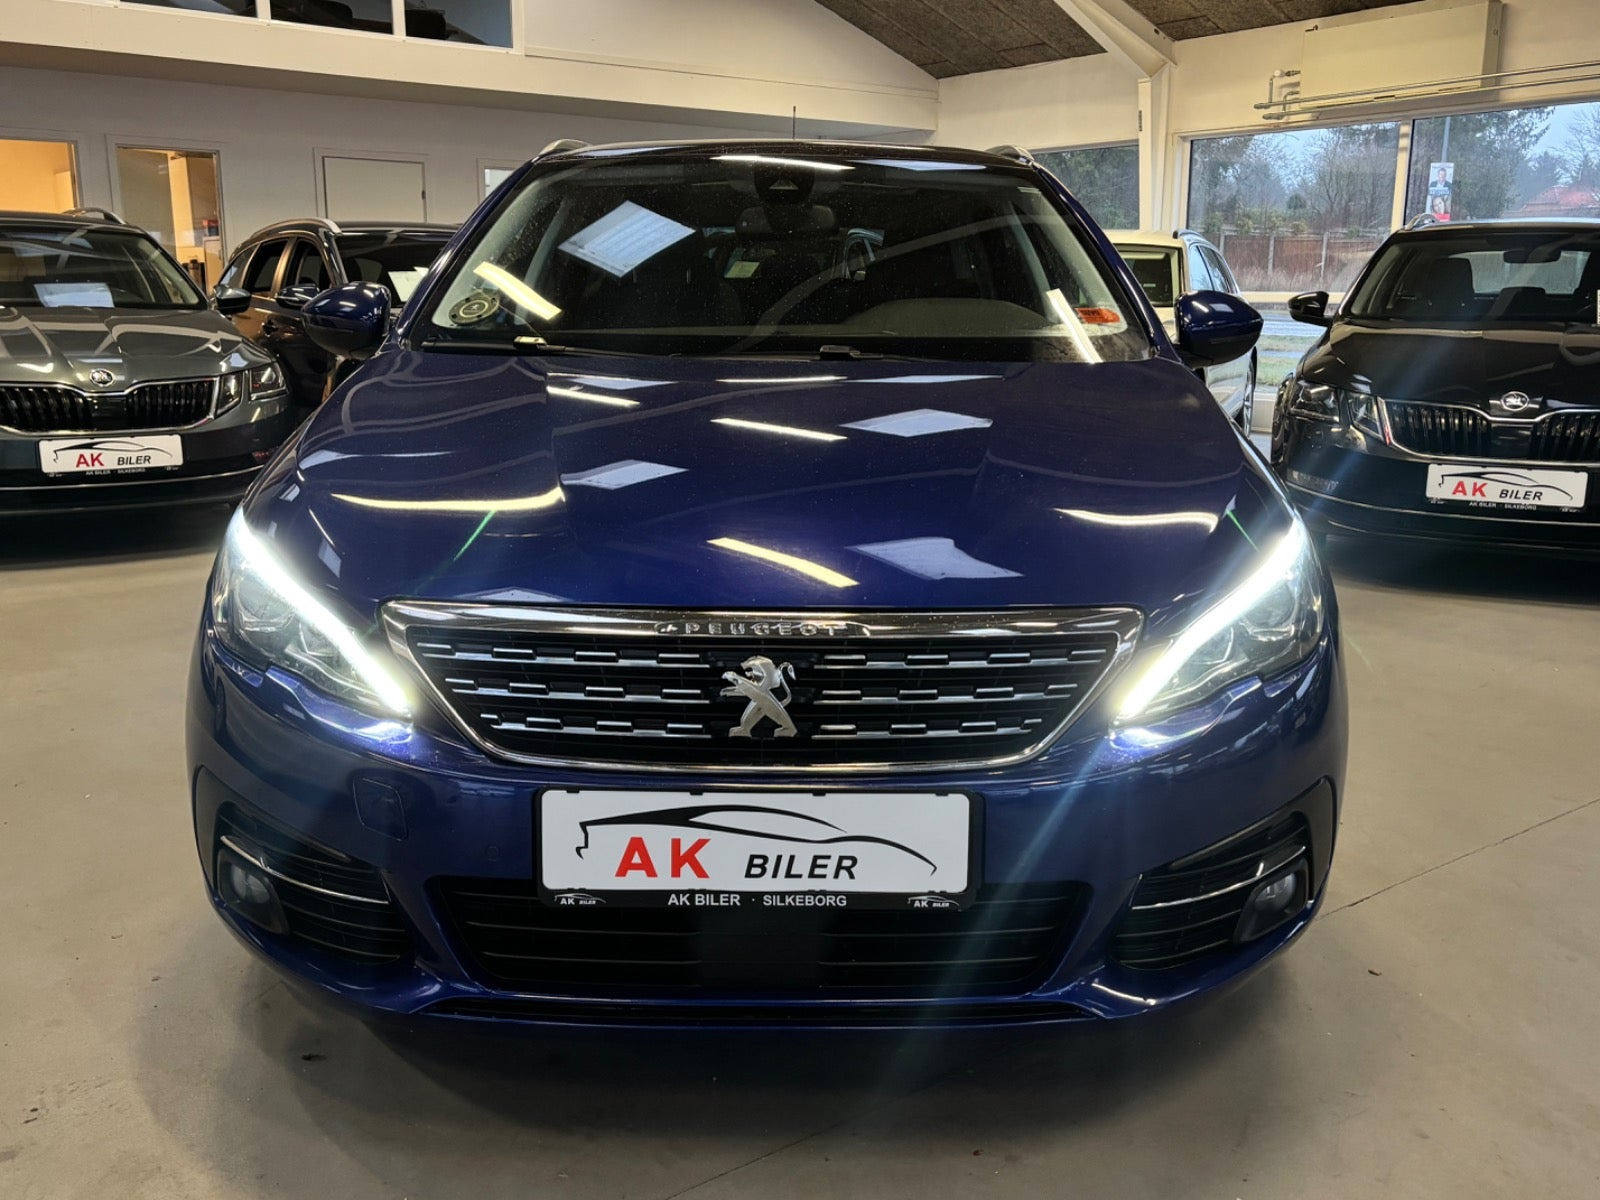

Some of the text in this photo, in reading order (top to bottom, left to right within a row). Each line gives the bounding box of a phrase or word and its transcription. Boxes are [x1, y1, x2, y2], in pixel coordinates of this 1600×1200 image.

[75, 453, 151, 468] AK BILER
[1452, 480, 1543, 501] AK BILER
[685, 622, 848, 636] PEUGEOT
[615, 837, 858, 880] AK BILER
[667, 893, 848, 907] AK BILER SILKEBORG
[913, 899, 929, 908] AK
